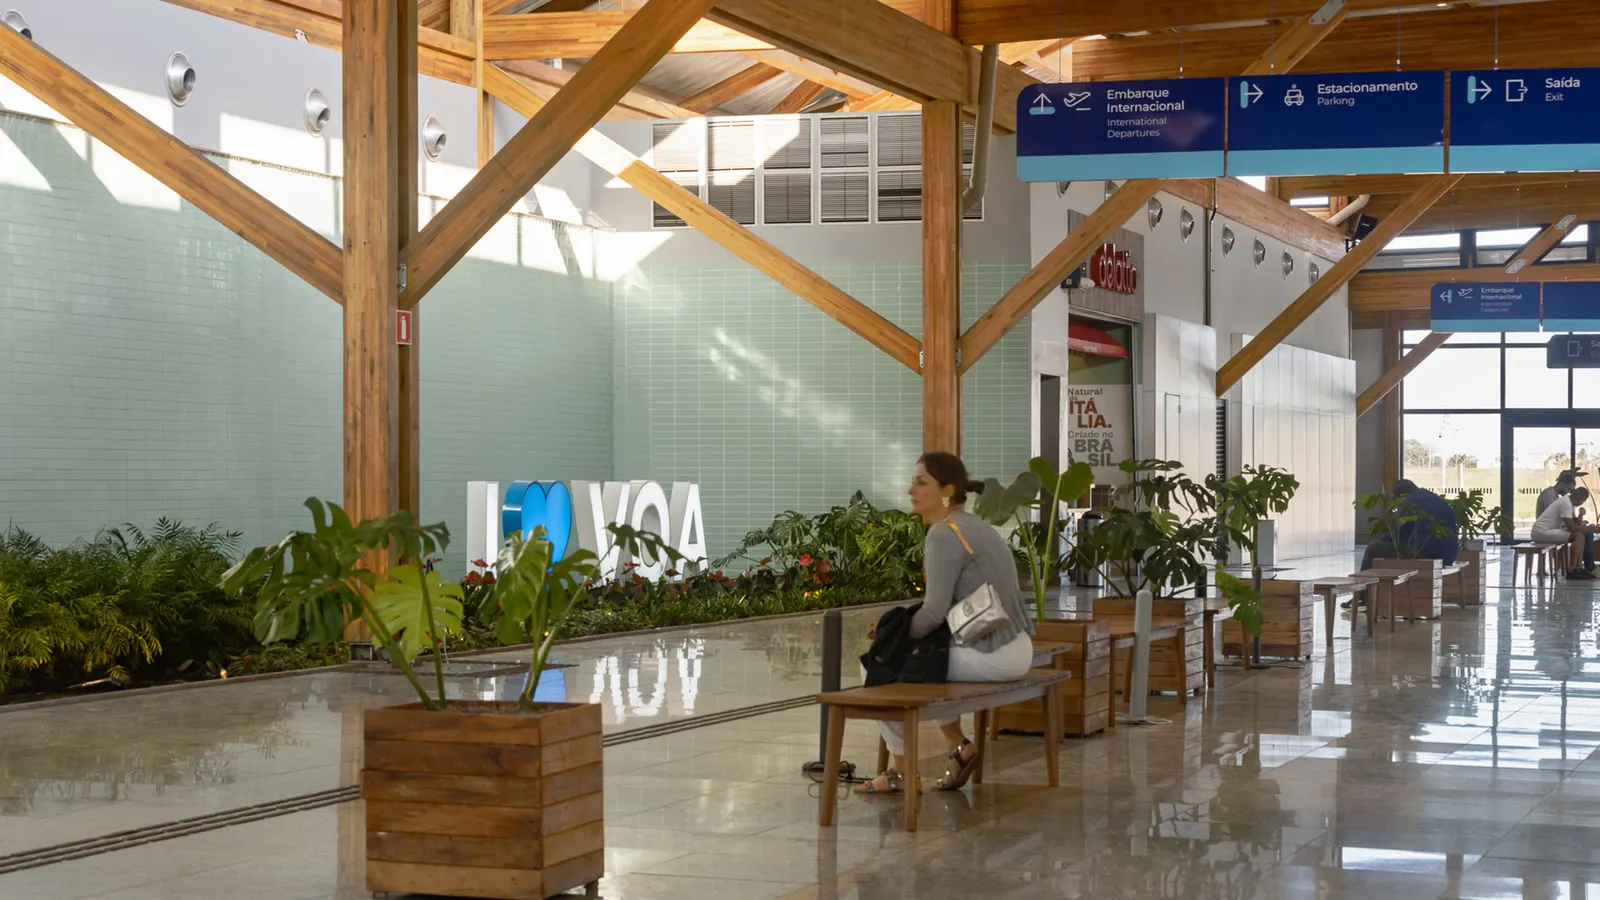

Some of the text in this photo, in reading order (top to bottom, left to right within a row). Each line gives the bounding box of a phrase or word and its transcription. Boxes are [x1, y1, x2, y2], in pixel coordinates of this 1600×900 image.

[1317, 81, 1418, 94] Estacionamento
[1545, 77, 1581, 88] Saída
[1107, 88, 1169, 100] Embarque
[1545, 92, 1564, 102] Exit
[1107, 100, 1185, 113] Internacional
[1317, 96, 1355, 106] Parking
[1107, 117, 1167, 127] International
[1107, 129, 1160, 139] Departures
[1068, 387, 1103, 396] Natural
[1069, 397, 1098, 414] ITÁ
[1077, 414, 1112, 428] LIA.
[1068, 430, 1100, 438] Criado
[1074, 439, 1115, 453] BRA
[571, 480, 708, 584] VOA
